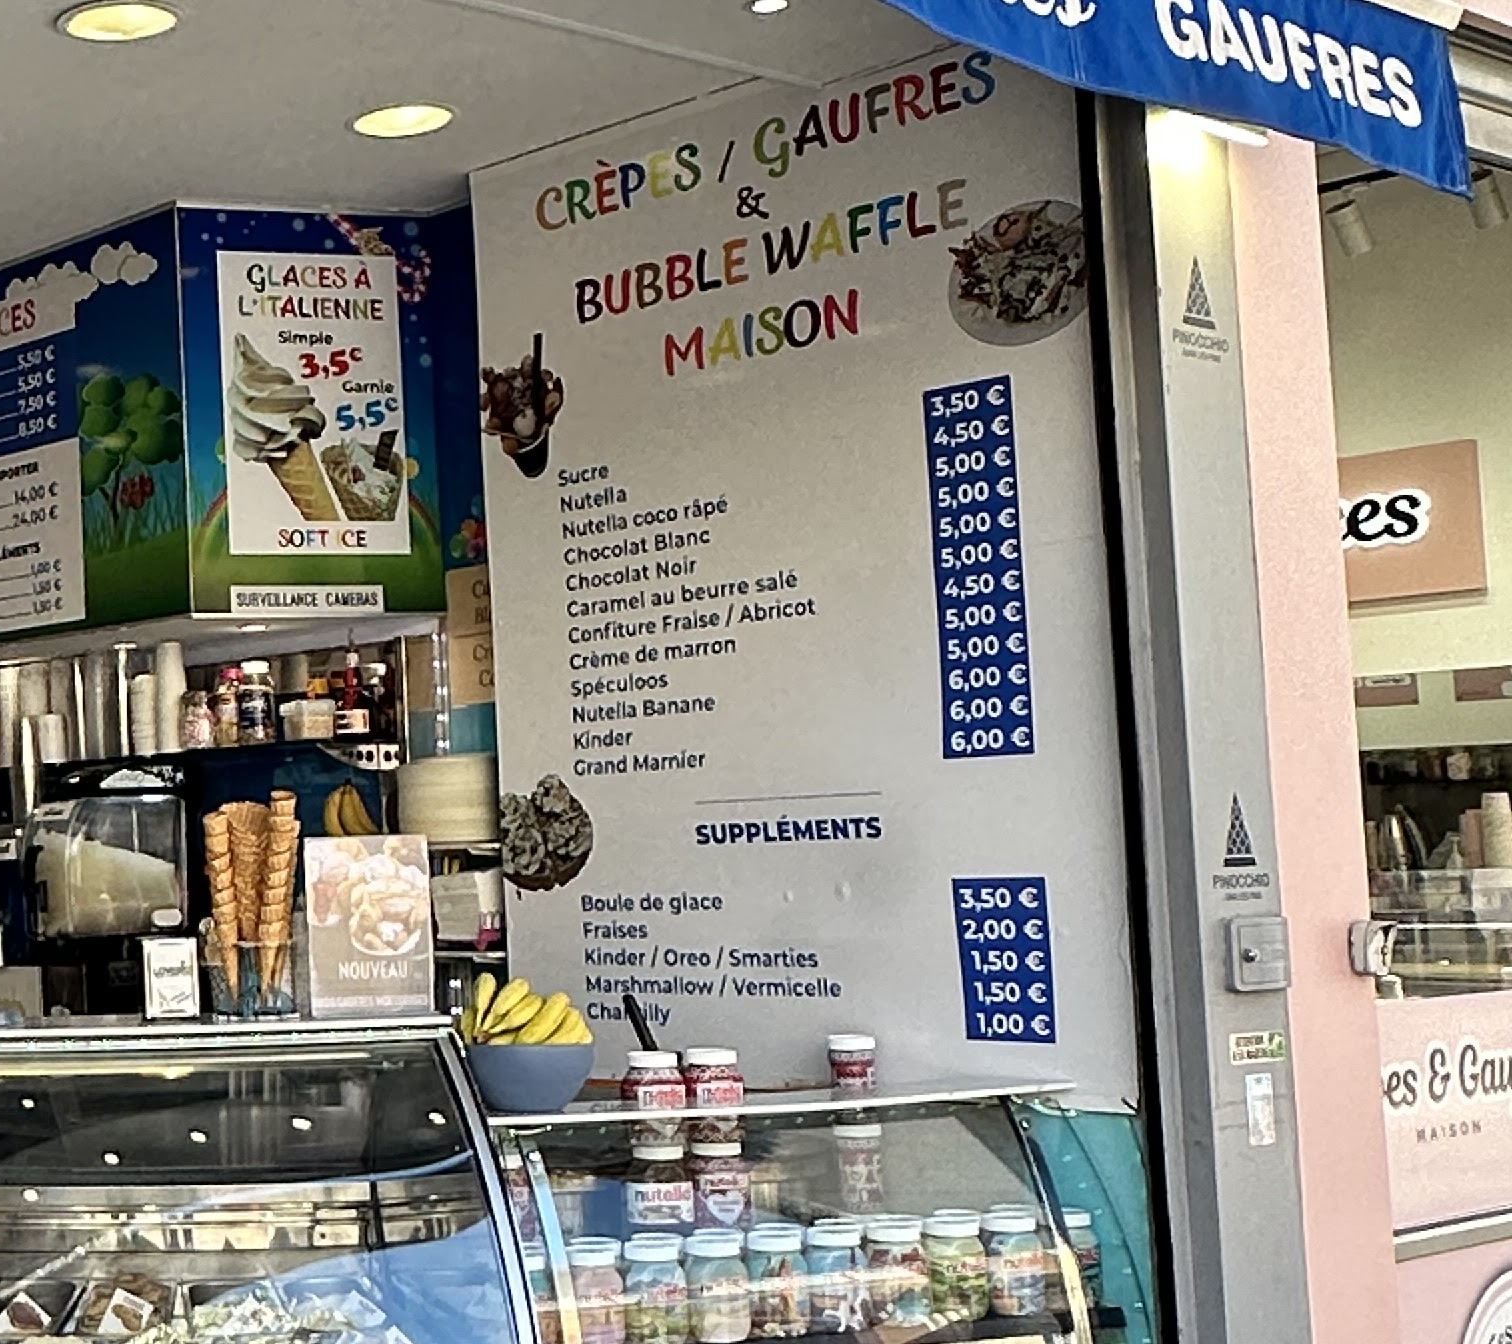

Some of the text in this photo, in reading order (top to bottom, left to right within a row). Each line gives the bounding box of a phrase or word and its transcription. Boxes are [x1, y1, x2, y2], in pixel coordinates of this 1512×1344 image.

[535, 51, 997, 231] CRÈPES GAUFRES
[736, 186, 769, 219] &
[575, 178, 969, 324] BUBBLE WAFFLE
[246, 260, 372, 294] GLACES À
[238, 295, 384, 321] L'ITALIENNE
[277, 329, 334, 347] Simple
[664, 288, 858, 376] MAISON
[341, 379, 395, 395] Garnie
[930, 389, 979, 418] 3,50
[933, 420, 984, 448] 4,50
[558, 465, 609, 487] Sucre
[935, 450, 986, 479] 5,00
[560, 488, 627, 513] Nutella
[937, 481, 990, 509] 5,00
[562, 493, 728, 539] Nutella coco râpé
[938, 511, 991, 539] 5,00
[1341, 494, 1421, 542] es
[278, 528, 368, 549] SOFT ICE
[563, 529, 710, 565] Chocolat Blanc
[940, 542, 993, 569] 5,00
[566, 556, 697, 591] Chocolat Noir
[942, 572, 995, 600] 4,50
[236, 591, 379, 607] SURVEILLANCE CAMERAS
[567, 568, 798, 617] Caramel au beurre salé
[568, 598, 816, 644] Confiture Fraise Abricot
[944, 603, 997, 631] 5,00
[570, 637, 736, 670] Crème de marron
[946, 634, 1000, 662] 5,00
[571, 672, 669, 699] Spéculoos
[948, 665, 1001, 692] 6,00
[572, 695, 715, 723] Nutella Banane
[949, 696, 1002, 723] 6,00
[573, 730, 633, 749] Kinder
[950, 727, 1004, 754] 6,00
[574, 749, 705, 776] Grand Marnier
[694, 815, 882, 846] SUPPLÉMENTS
[580, 892, 723, 917] Boule de glace
[959, 887, 1010, 913] 3,50
[582, 921, 648, 941] Fraises
[963, 919, 1016, 944] 2,00
[338, 960, 408, 980] NOUVEAU
[584, 948, 818, 969] Kinder Oreo Smarties
[970, 950, 1019, 975] 1,50
[586, 976, 842, 998] Marshmallow Vermicelle
[973, 981, 1020, 1007] 1,50
[587, 1002, 671, 1027] Chailly
[975, 1013, 1025, 1037] 1,00
[1381, 1068, 1418, 1109] es
[1415, 1120, 1482, 1144] MAISON
